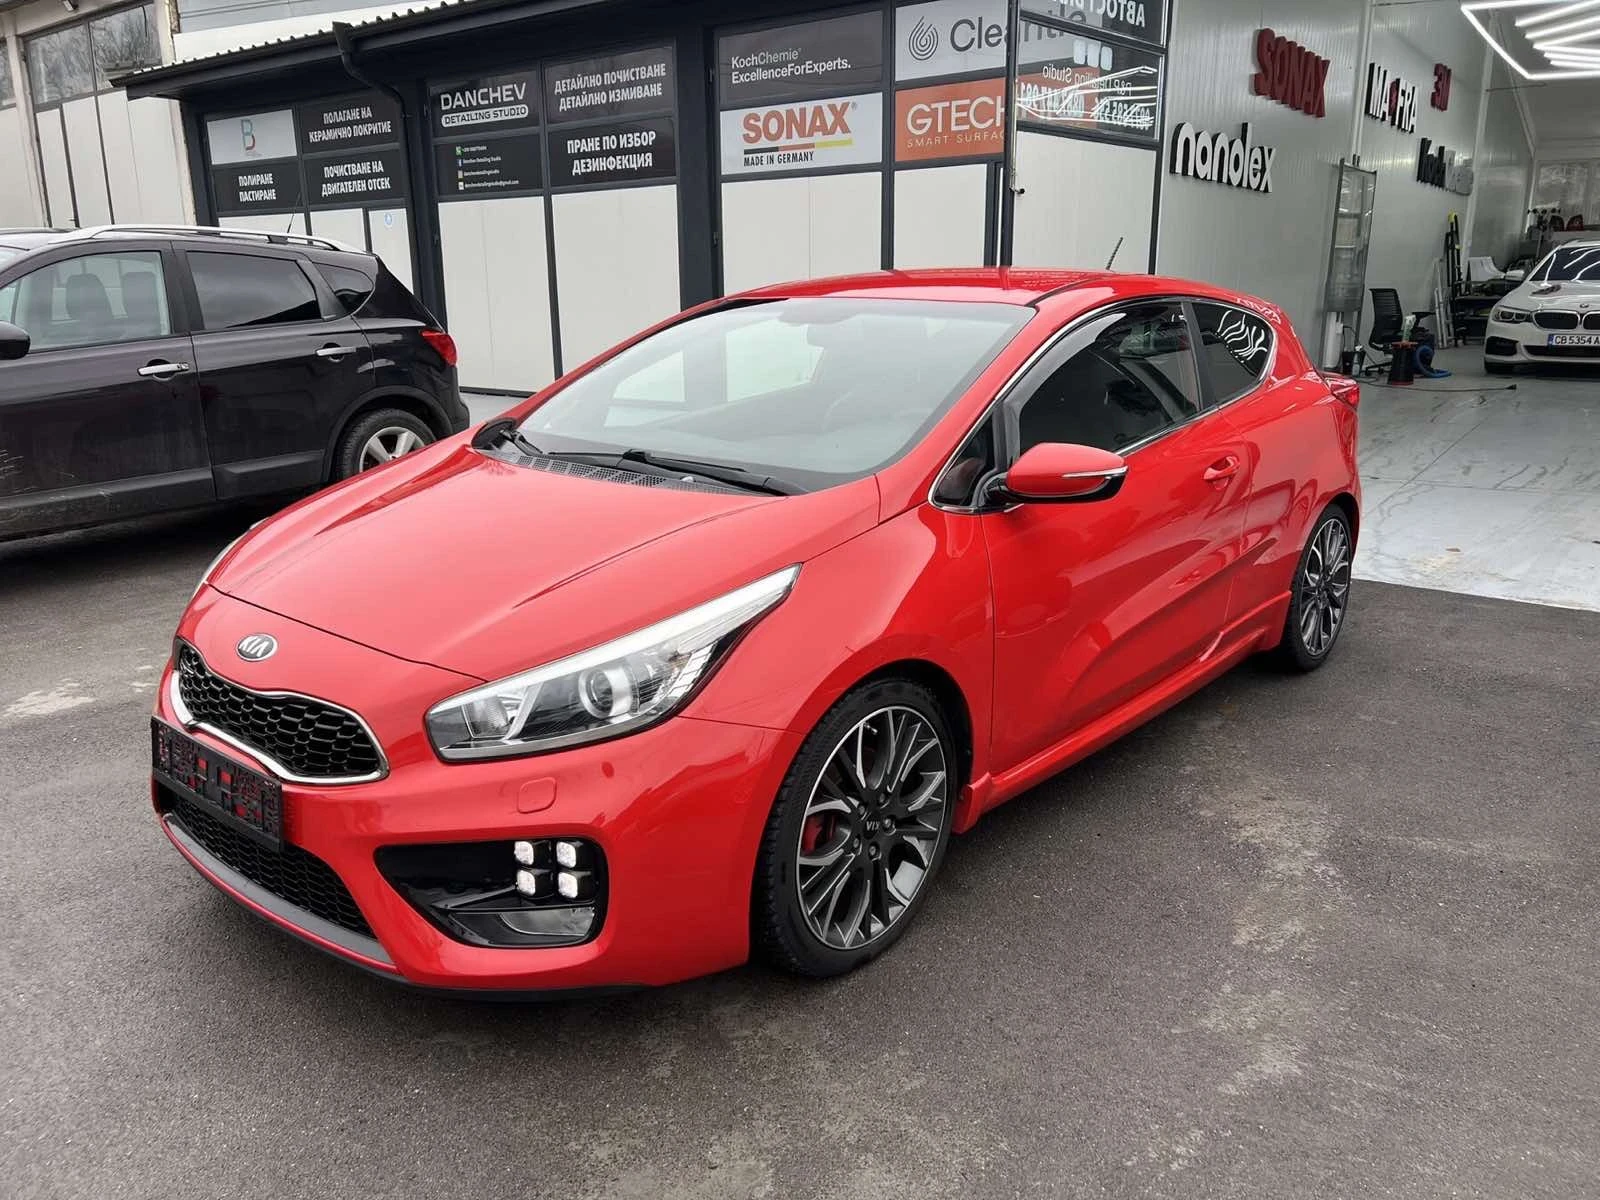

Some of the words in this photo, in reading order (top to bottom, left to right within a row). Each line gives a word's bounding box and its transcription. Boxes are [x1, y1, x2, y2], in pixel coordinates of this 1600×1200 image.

[731, 49, 799, 69] KochChemie
[555, 73, 602, 95] ДЕТАЙЛНО
[604, 63, 666, 84] ПОЧИСТВАНЕ
[731, 57, 851, 84] ExcellenceForExperts.
[1250, 27, 1330, 118] SONAX
[440, 82, 526, 111] DANCHEV
[559, 92, 607, 112] ДЕТАЙЛНО
[608, 83, 662, 102] ИЗМИВАНЕ
[323, 107, 360, 125] ПОЛАГАНЕ
[361, 106, 373, 118] НА
[444, 110, 491, 125] DETAILING
[492, 106, 527, 119] STUDIO
[742, 102, 852, 144] SONAX
[309, 126, 352, 143] КЕРАМИЧНО
[353, 121, 392, 136] ПОКРИТИЕ
[567, 138, 600, 154] ПРАНЕ
[602, 135, 617, 149] ПО
[619, 131, 656, 148] ИЗБОР
[907, 136, 949, 149] SMART
[323, 161, 371, 178] ПОЧИСТВАНЕ
[372, 160, 384, 173] НА
[572, 152, 653, 176] ДЕЗИНФЕКЦИЯ
[743, 153, 765, 167] MADE
[766, 152, 775, 165] IN
[777, 151, 815, 164] GERMANY
[238, 173, 273, 187] ПОЛИРАНЕ
[321, 179, 367, 197] ДВИГАТЕЛЕН
[367, 177, 391, 192] ОТСЕК
[239, 189, 276, 202] ПАСТИРАНЕ
[1555, 335, 1567, 345] CB
[1568, 335, 1592, 345] 5354
[238, 635, 269, 659] KIA
